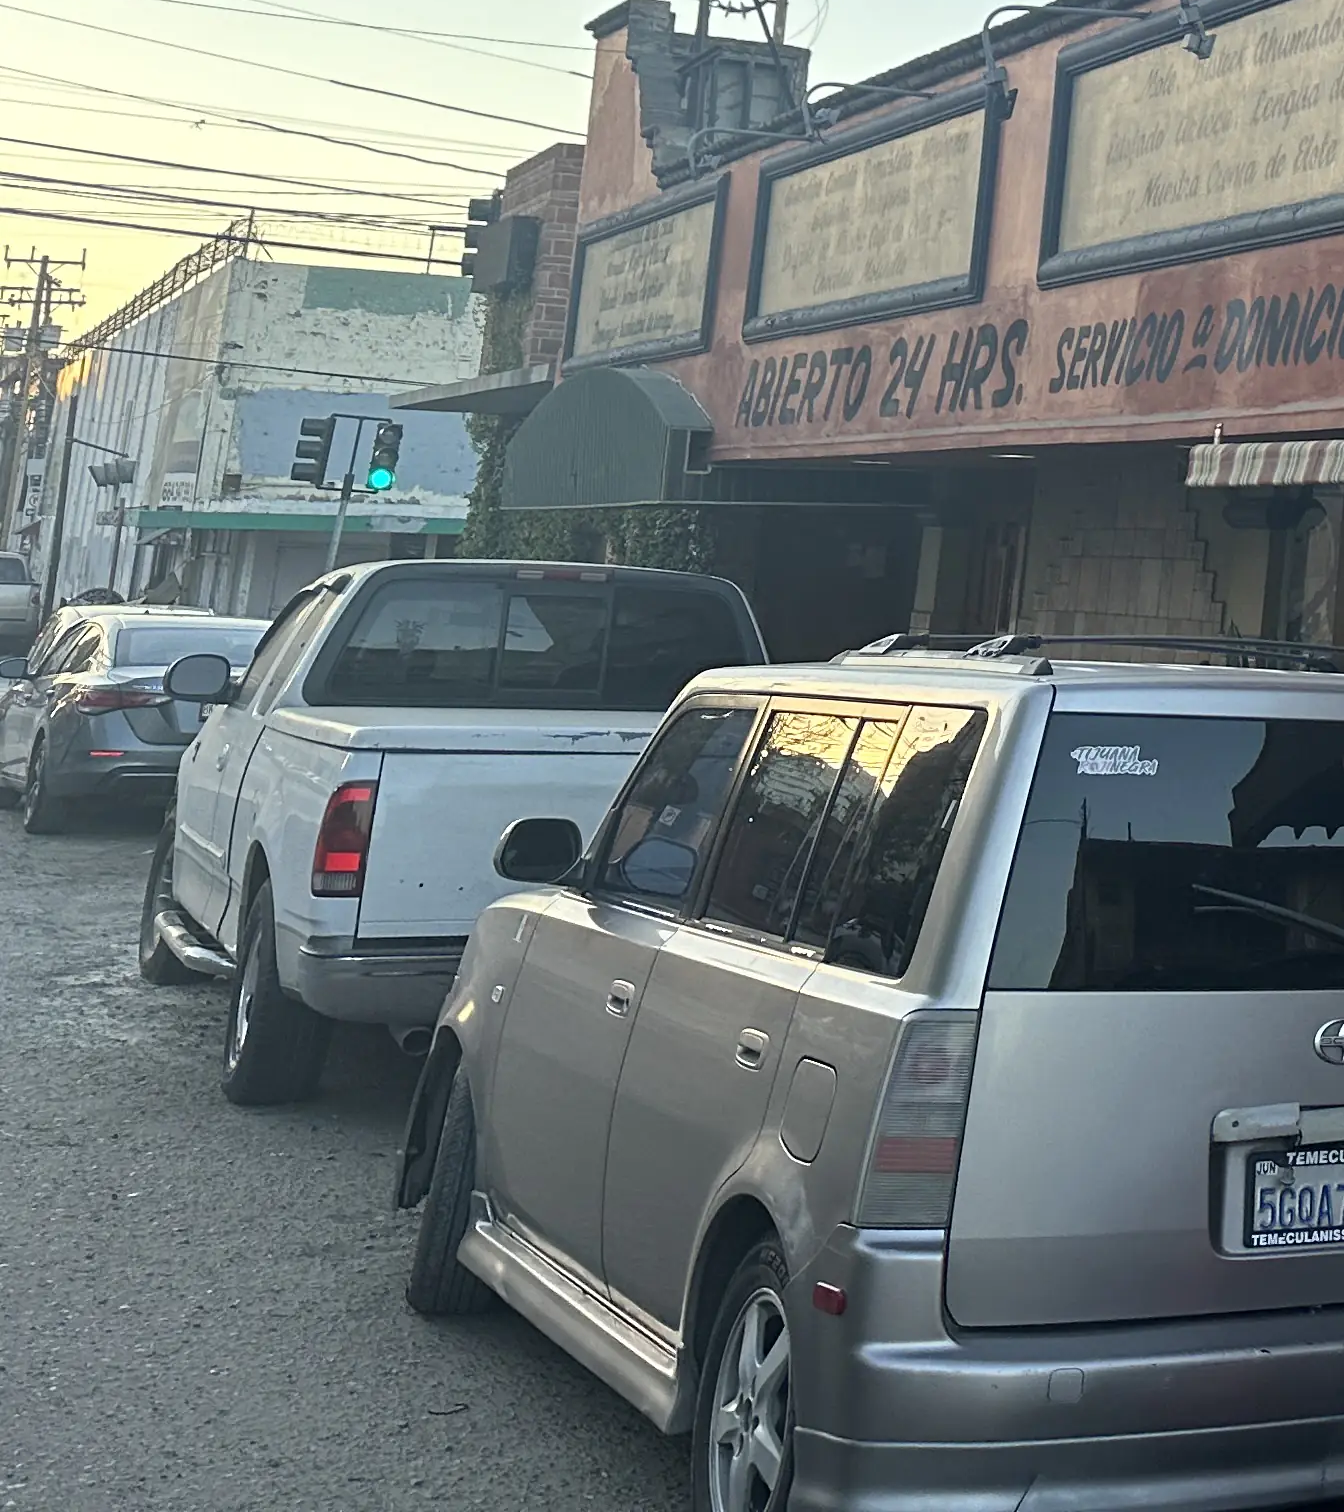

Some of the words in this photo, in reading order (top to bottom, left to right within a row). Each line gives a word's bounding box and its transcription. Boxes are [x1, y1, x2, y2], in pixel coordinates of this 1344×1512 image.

[1264, 142, 1287, 181] de
[1048, 307, 1185, 394] SERVICIO
[735, 344, 872, 429] ABIERTO
[878, 333, 935, 420] 24
[935, 318, 1029, 414] HRS.
[1077, 746, 1140, 762] TIJUANA
[1256, 1161, 1278, 1176] JUN
